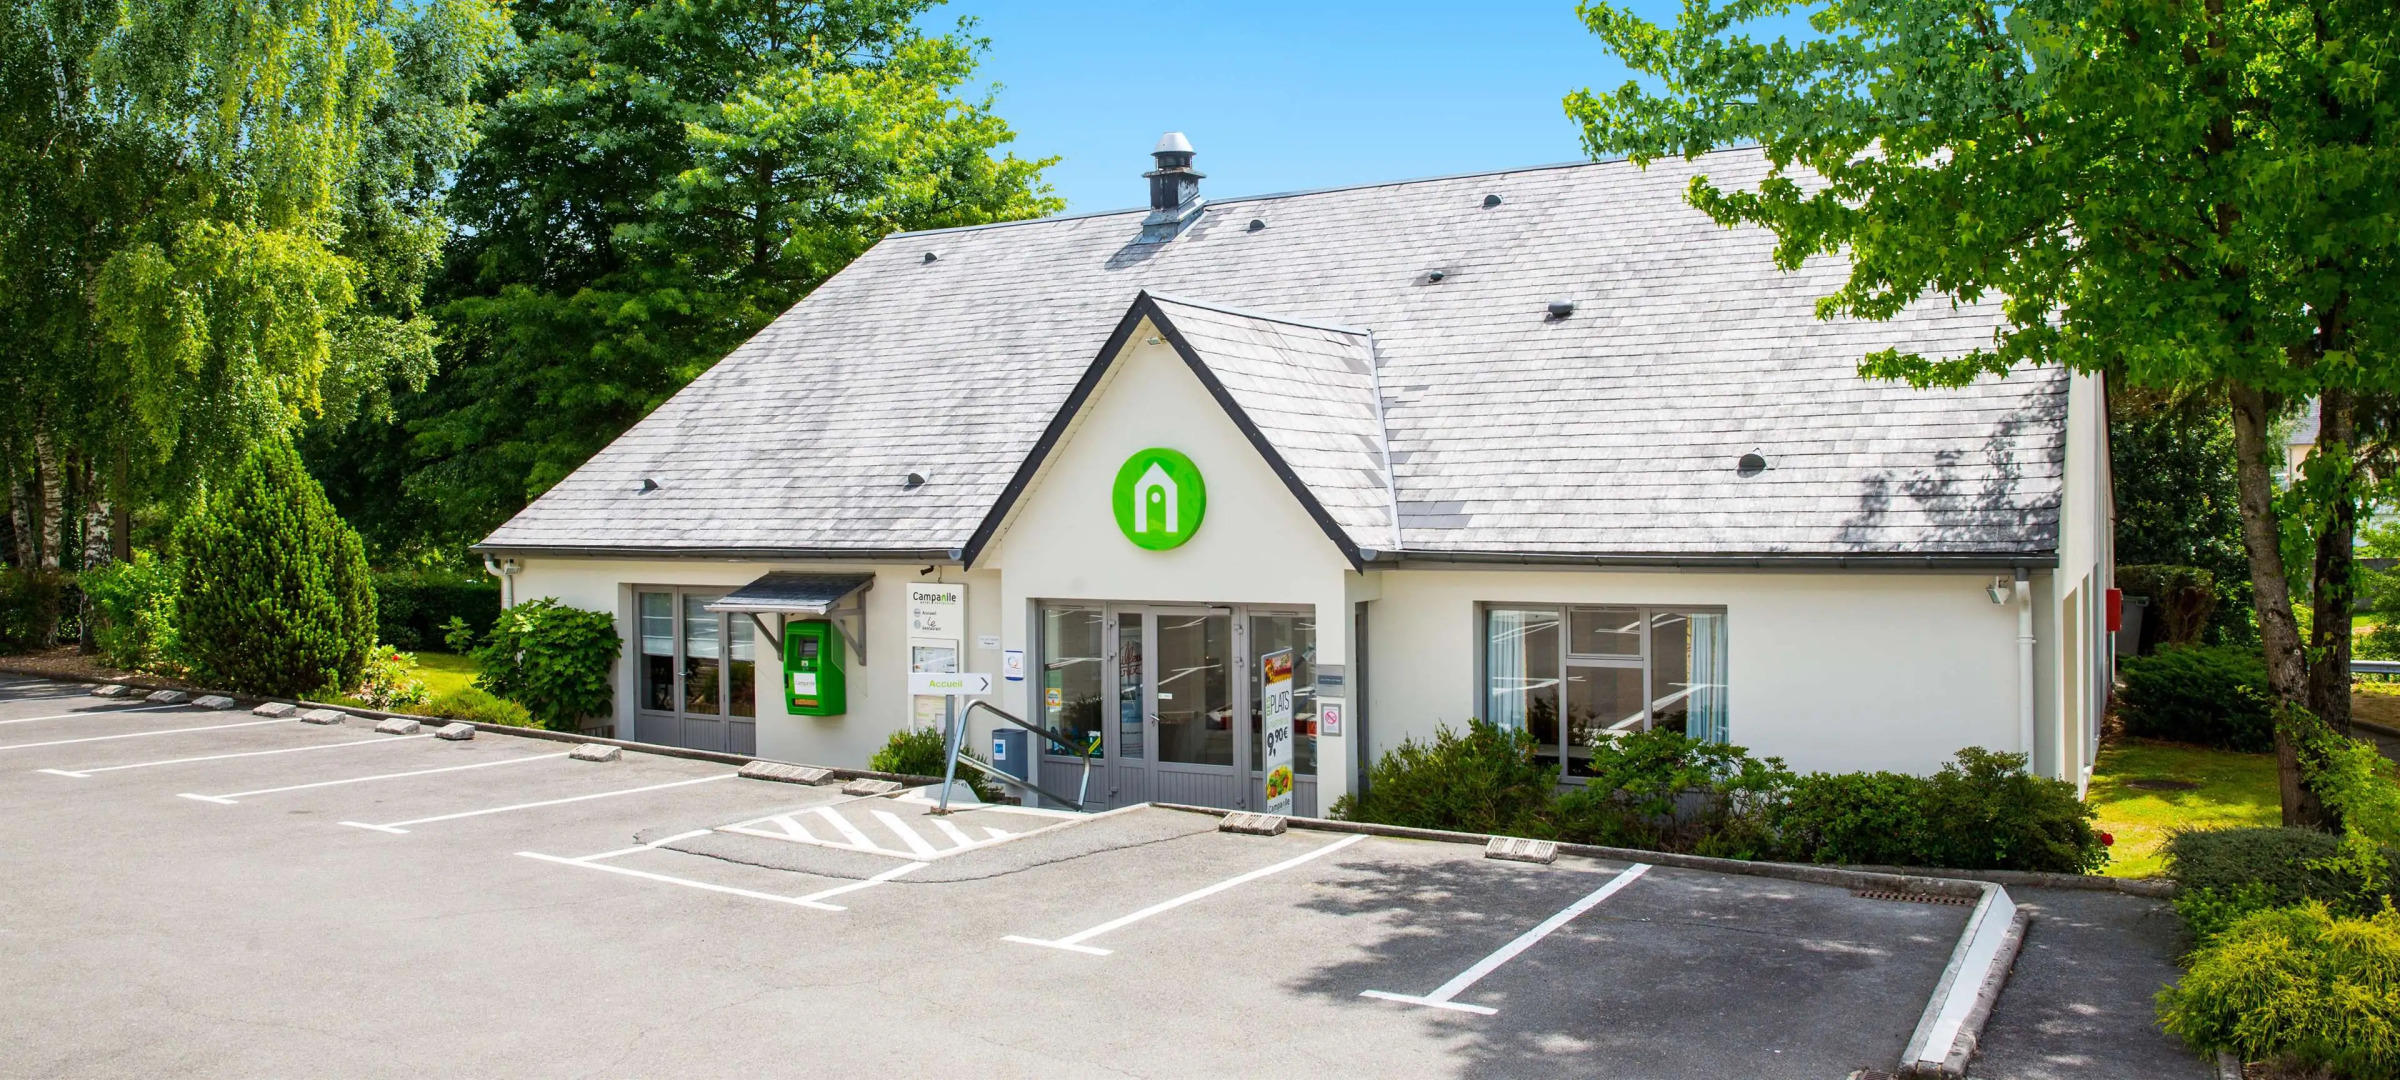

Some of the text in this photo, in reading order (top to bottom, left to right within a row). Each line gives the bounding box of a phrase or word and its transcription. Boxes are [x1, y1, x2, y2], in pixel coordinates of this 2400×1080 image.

[913, 591, 957, 604] Campanile
[929, 679, 963, 688] Accueil
[1270, 690, 1290, 715] PLATS
